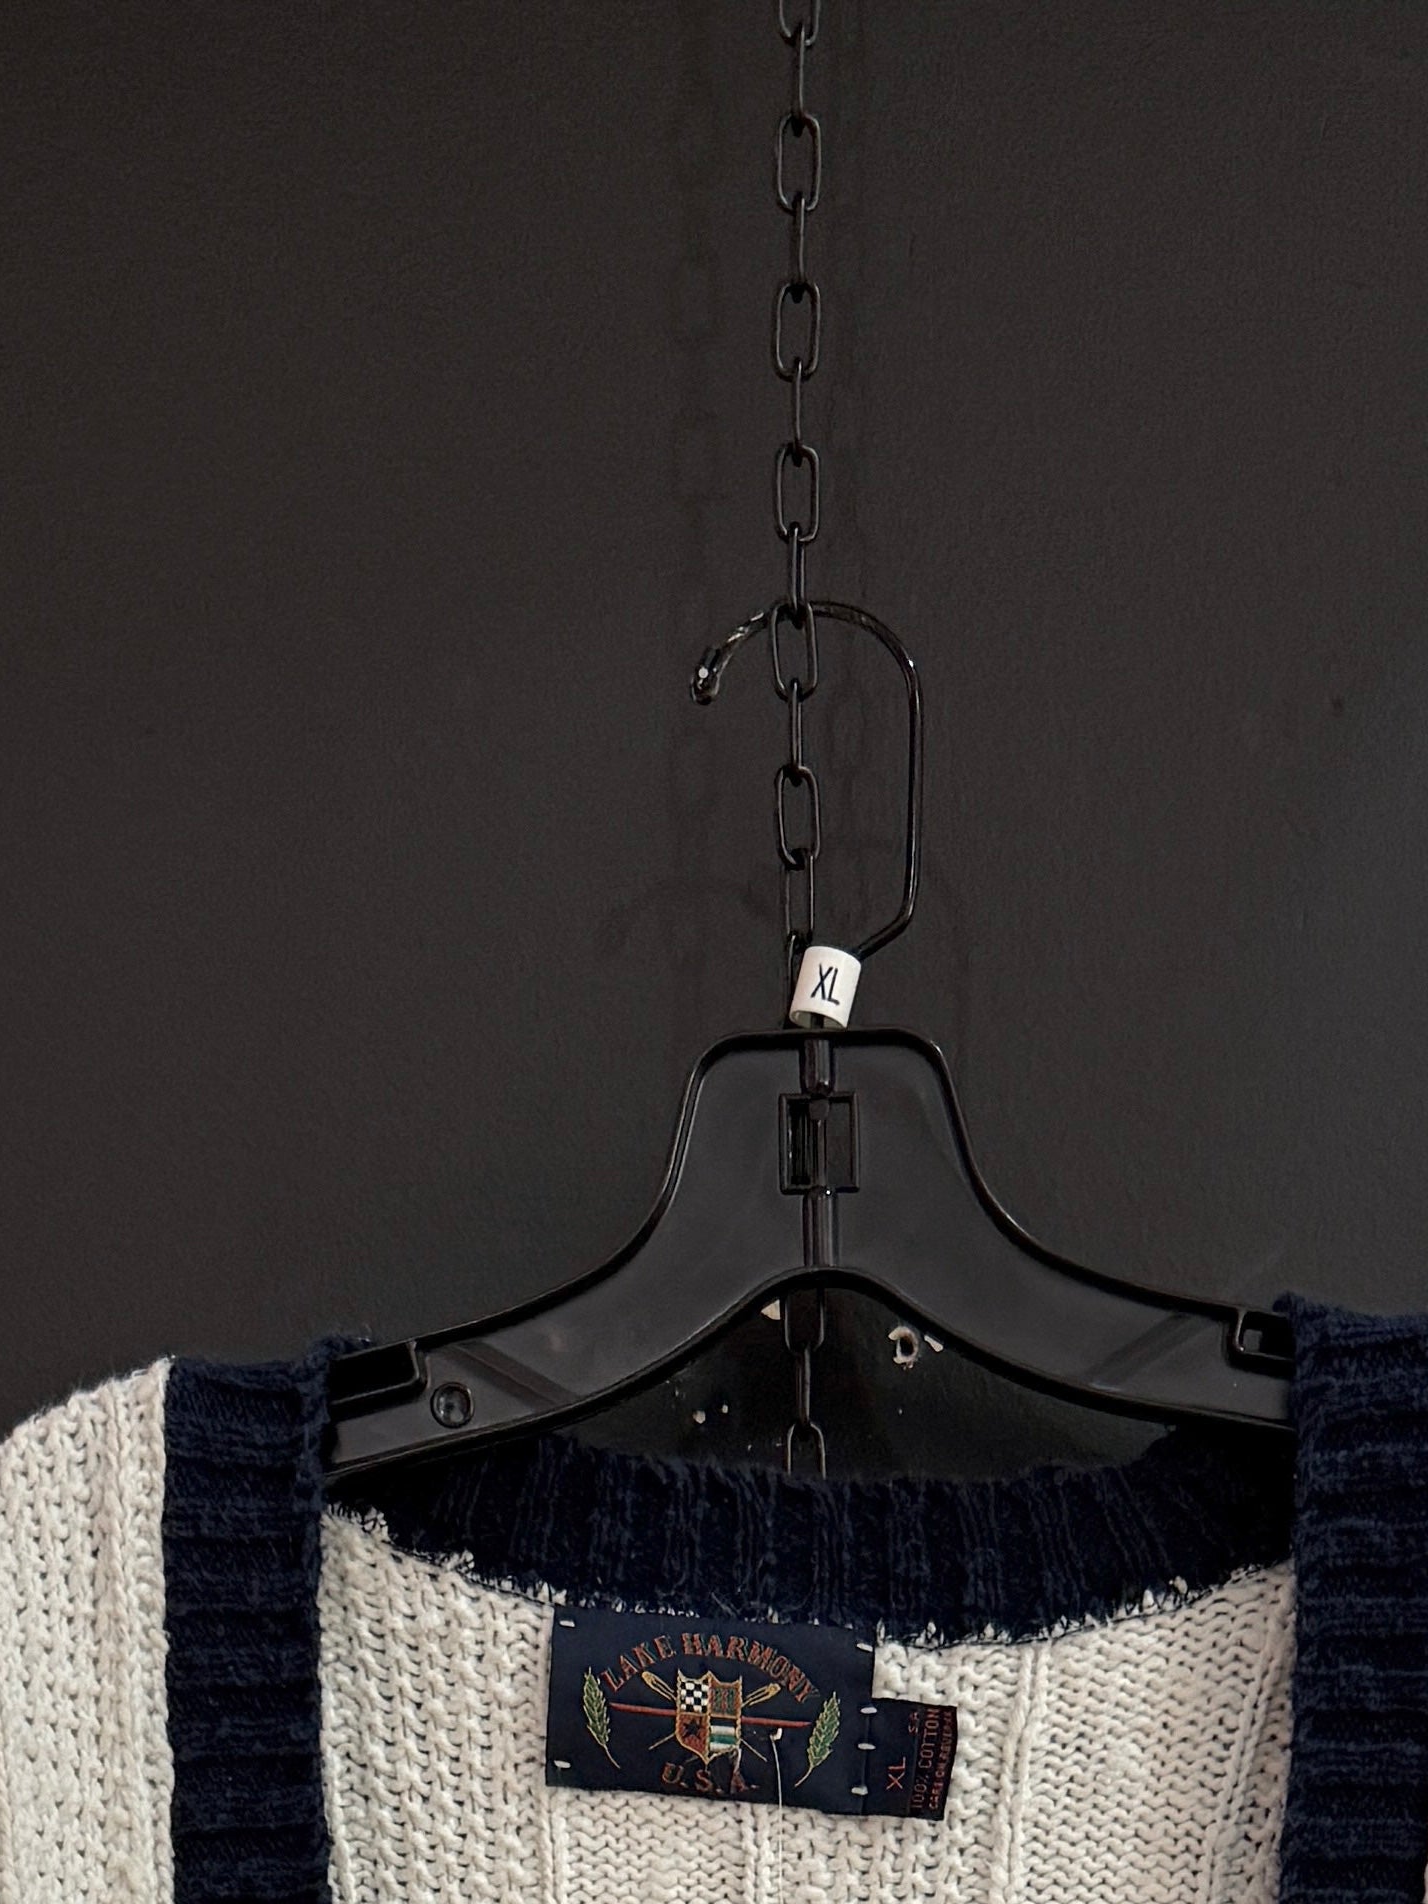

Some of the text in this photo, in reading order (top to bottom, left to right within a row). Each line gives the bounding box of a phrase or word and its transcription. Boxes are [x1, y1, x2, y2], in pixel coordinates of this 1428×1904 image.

[810, 963, 841, 1006] XL
[601, 1632, 821, 1704] LAKE HARMONY
[918, 1707, 940, 1769] COTTON
[886, 1756, 907, 1790] XL
